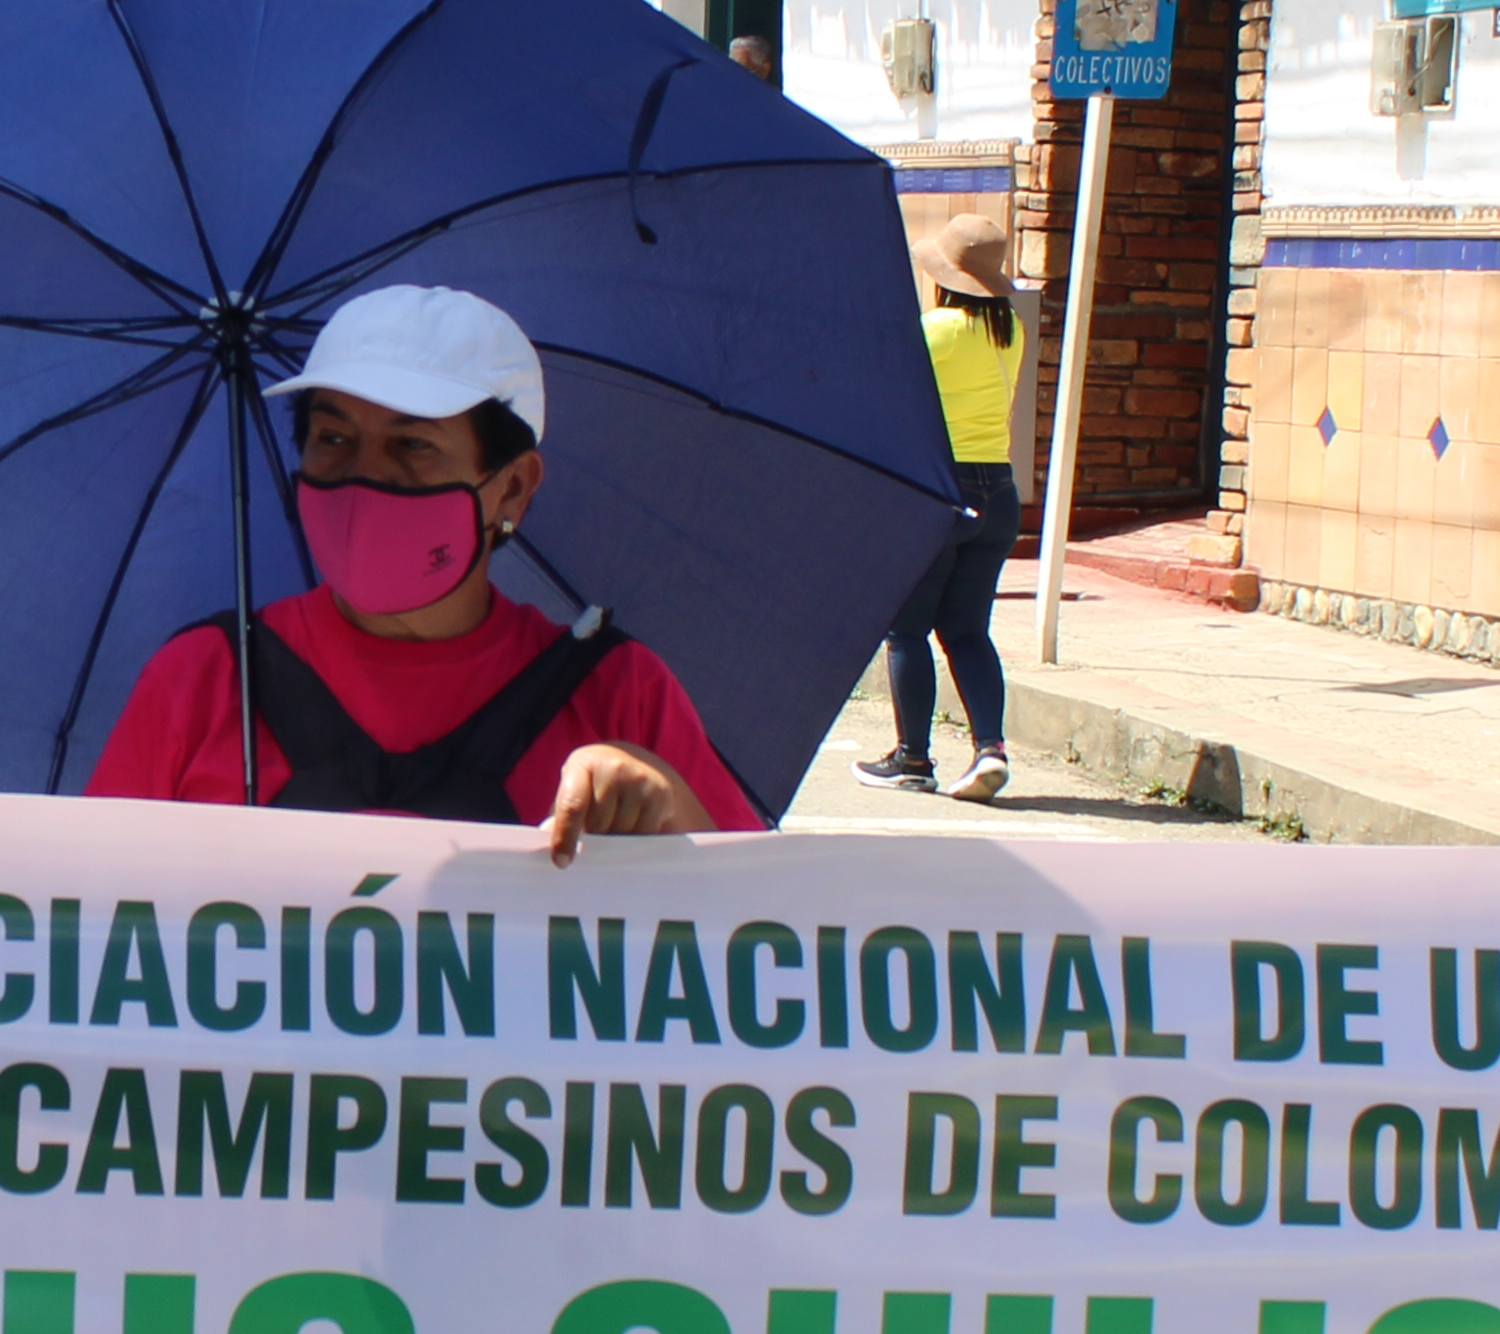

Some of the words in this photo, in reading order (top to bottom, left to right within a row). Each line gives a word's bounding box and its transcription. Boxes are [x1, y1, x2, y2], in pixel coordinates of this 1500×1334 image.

[1054, 55, 1167, 85] COLECTIVOS
[546, 913, 1188, 1061] NACIONAL
[1229, 939, 1385, 1066] DE
[901, 1089, 1060, 1220] DE
